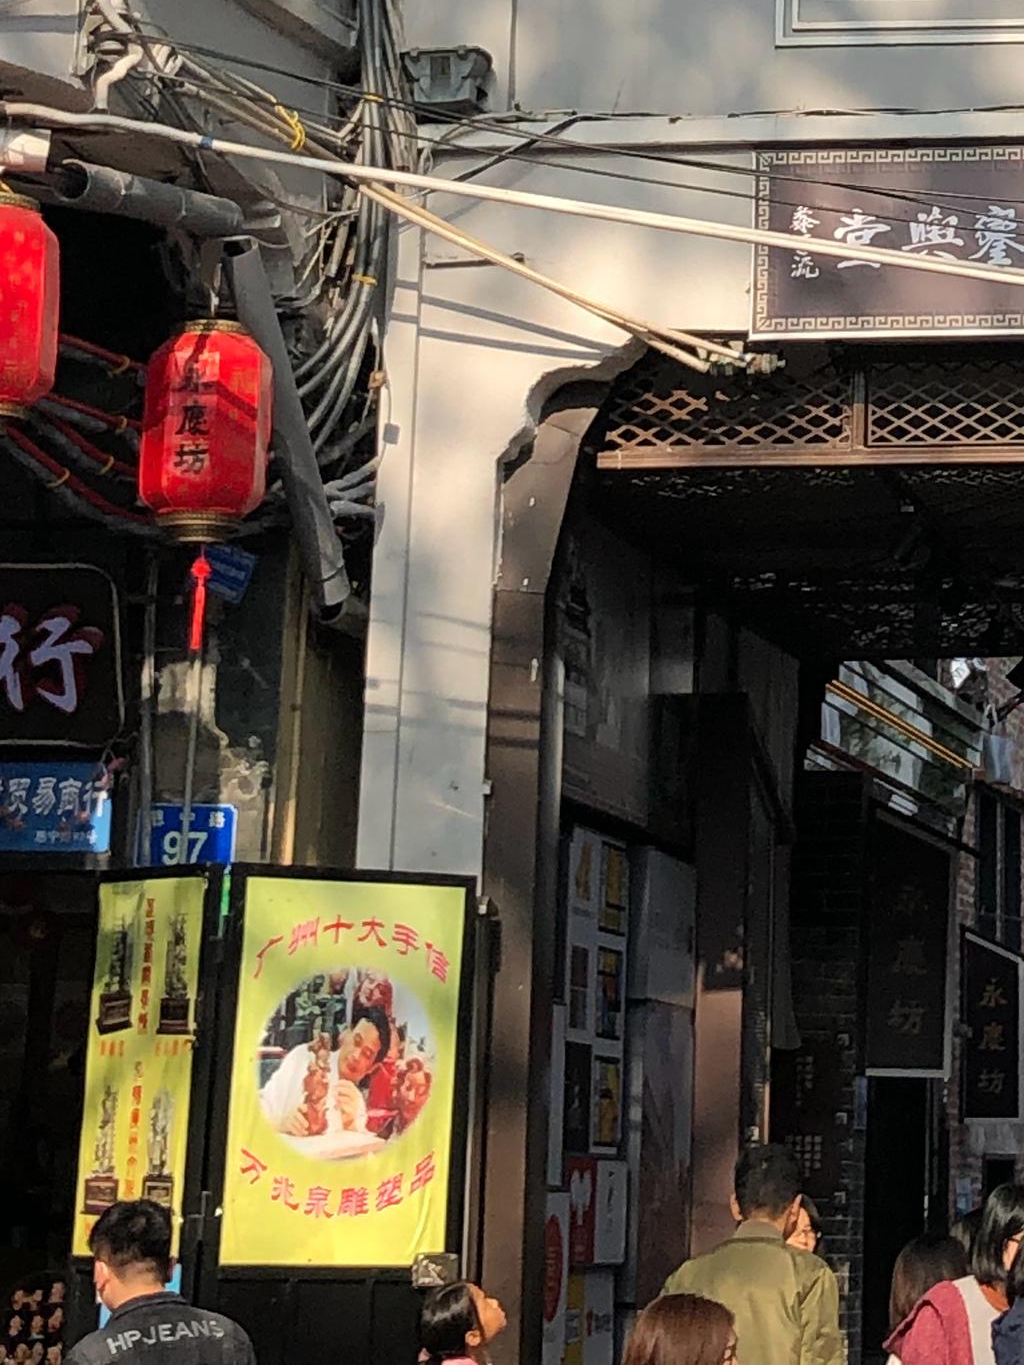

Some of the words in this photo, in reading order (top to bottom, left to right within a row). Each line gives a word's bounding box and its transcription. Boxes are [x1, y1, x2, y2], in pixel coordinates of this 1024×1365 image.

[791, 205, 820, 279] 黎流
[0, 777, 109, 818] 贸易商行
[161, 830, 209, 866] 97
[253, 914, 450, 986] 广州十大手信
